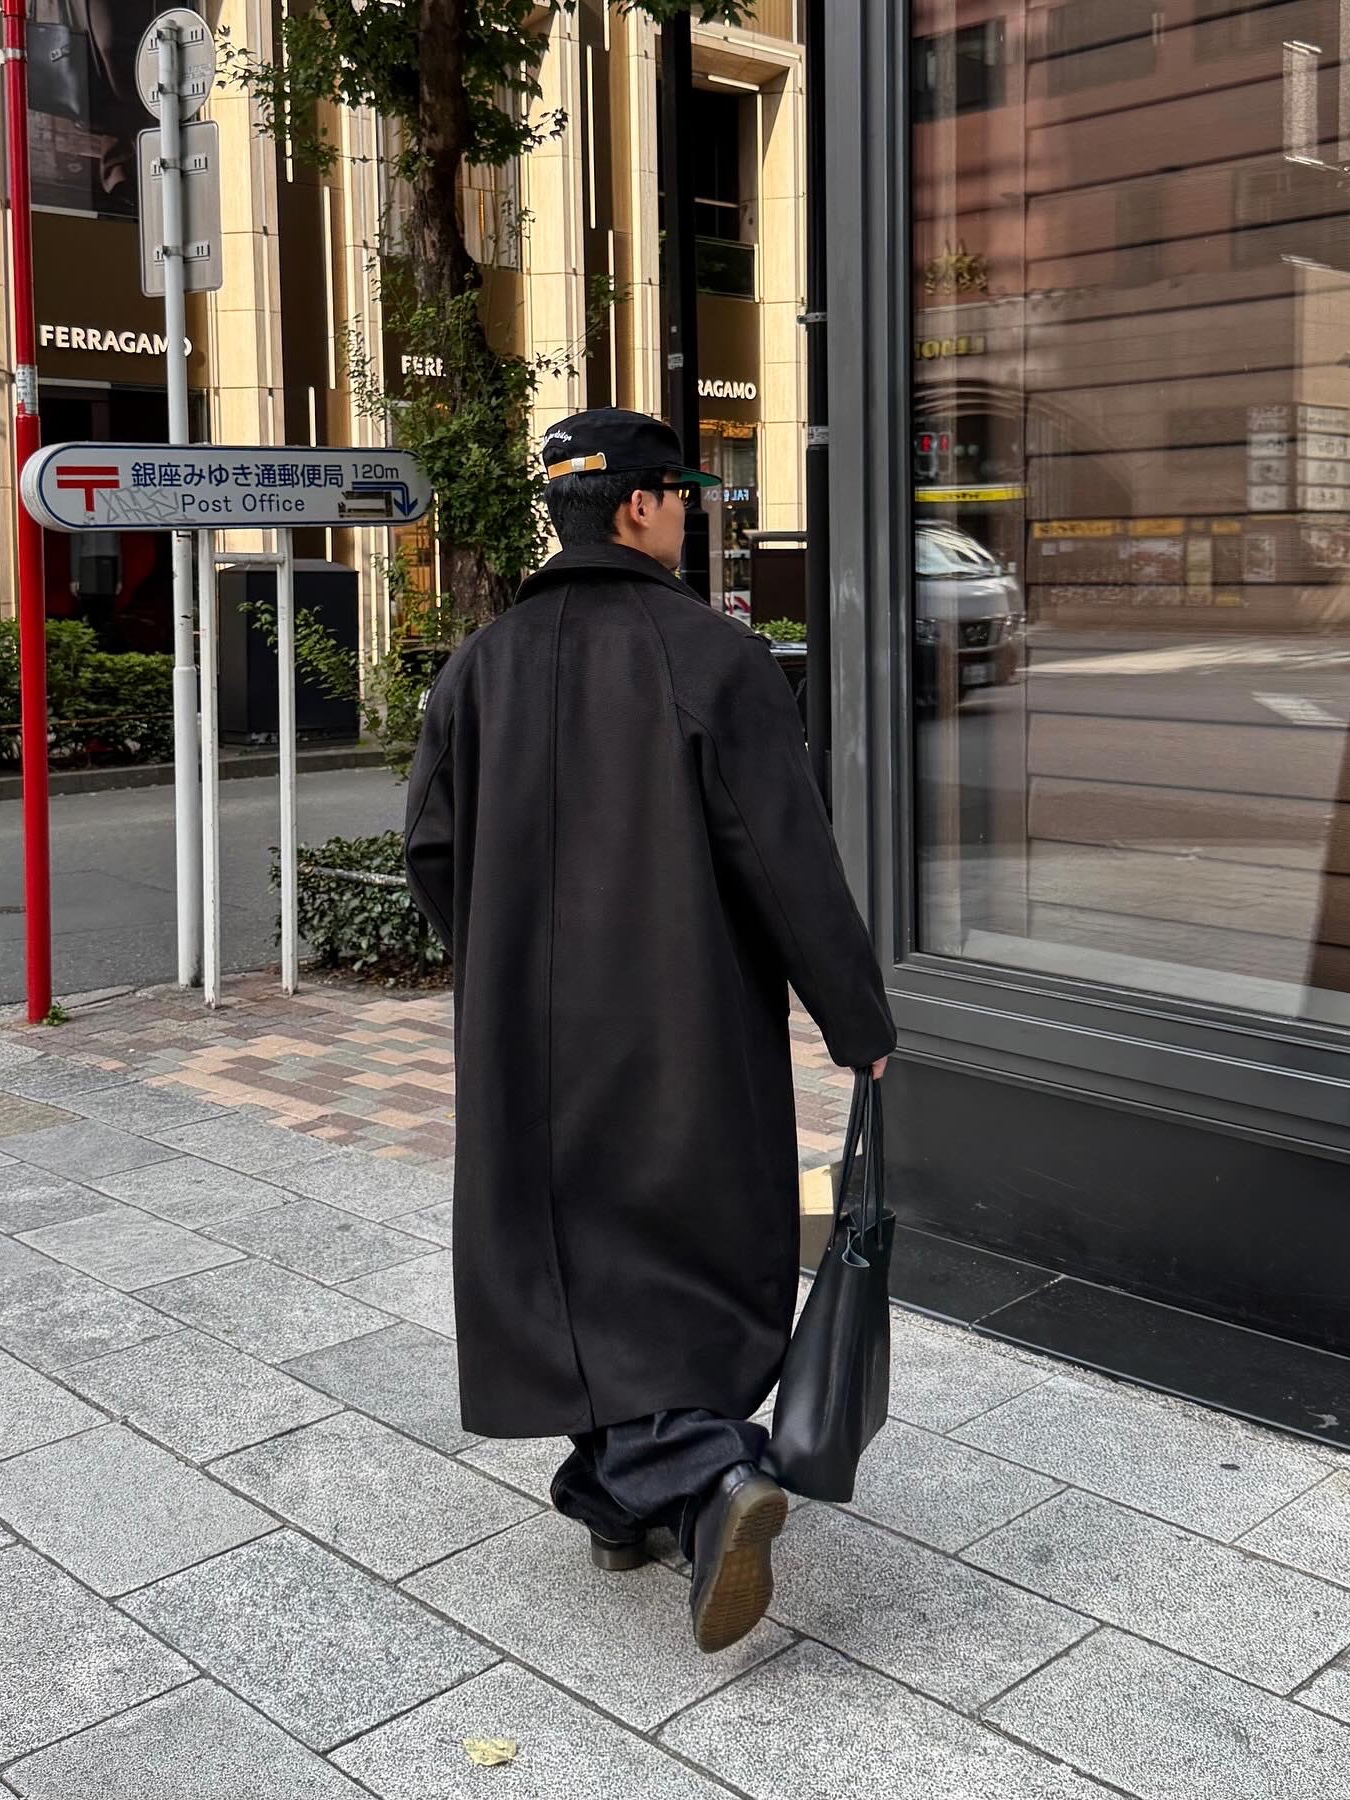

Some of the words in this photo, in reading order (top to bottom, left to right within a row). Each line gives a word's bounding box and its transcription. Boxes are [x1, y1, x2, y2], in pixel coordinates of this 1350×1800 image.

[131, 462, 343, 488] 銀座みゆき通郵便局
[352, 463, 400, 479] 120m
[181, 494, 232, 513] Post
[242, 493, 306, 512] Office
